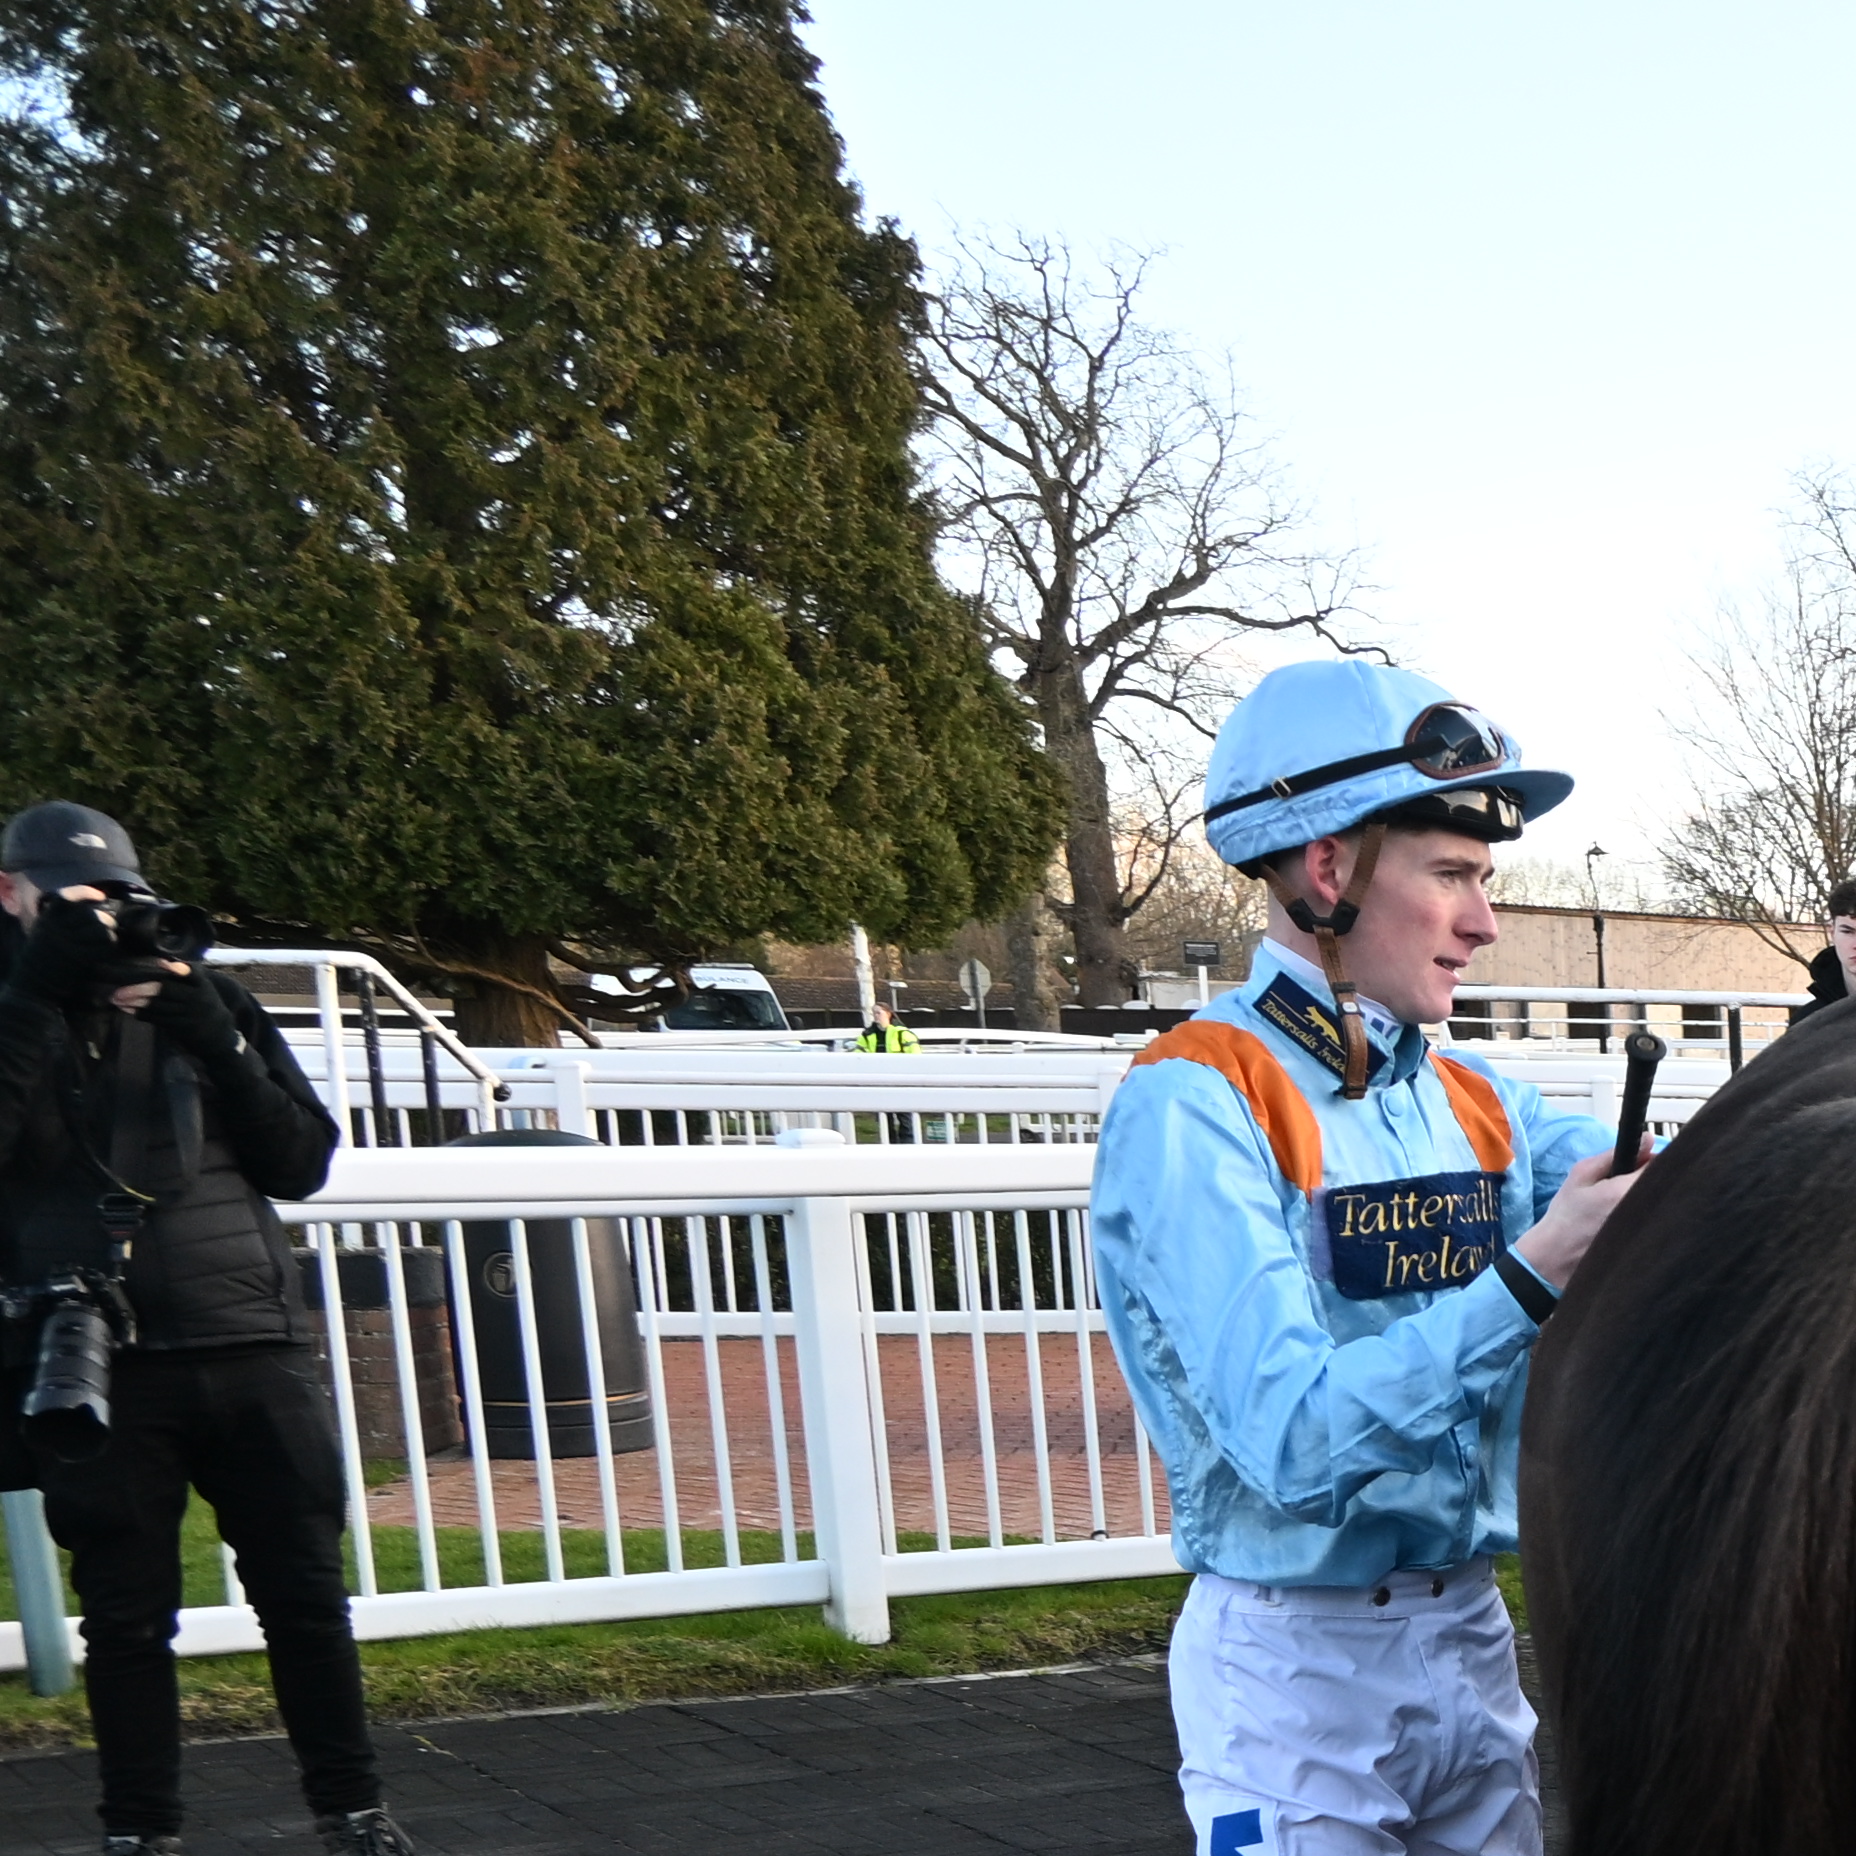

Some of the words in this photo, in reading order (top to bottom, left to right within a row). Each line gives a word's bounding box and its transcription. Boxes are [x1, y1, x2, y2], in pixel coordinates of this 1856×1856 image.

[696, 976, 748, 984] BULANCE
[1261, 998, 1318, 1049] Tattersalls
[1317, 1047, 1346, 1074] Irela
